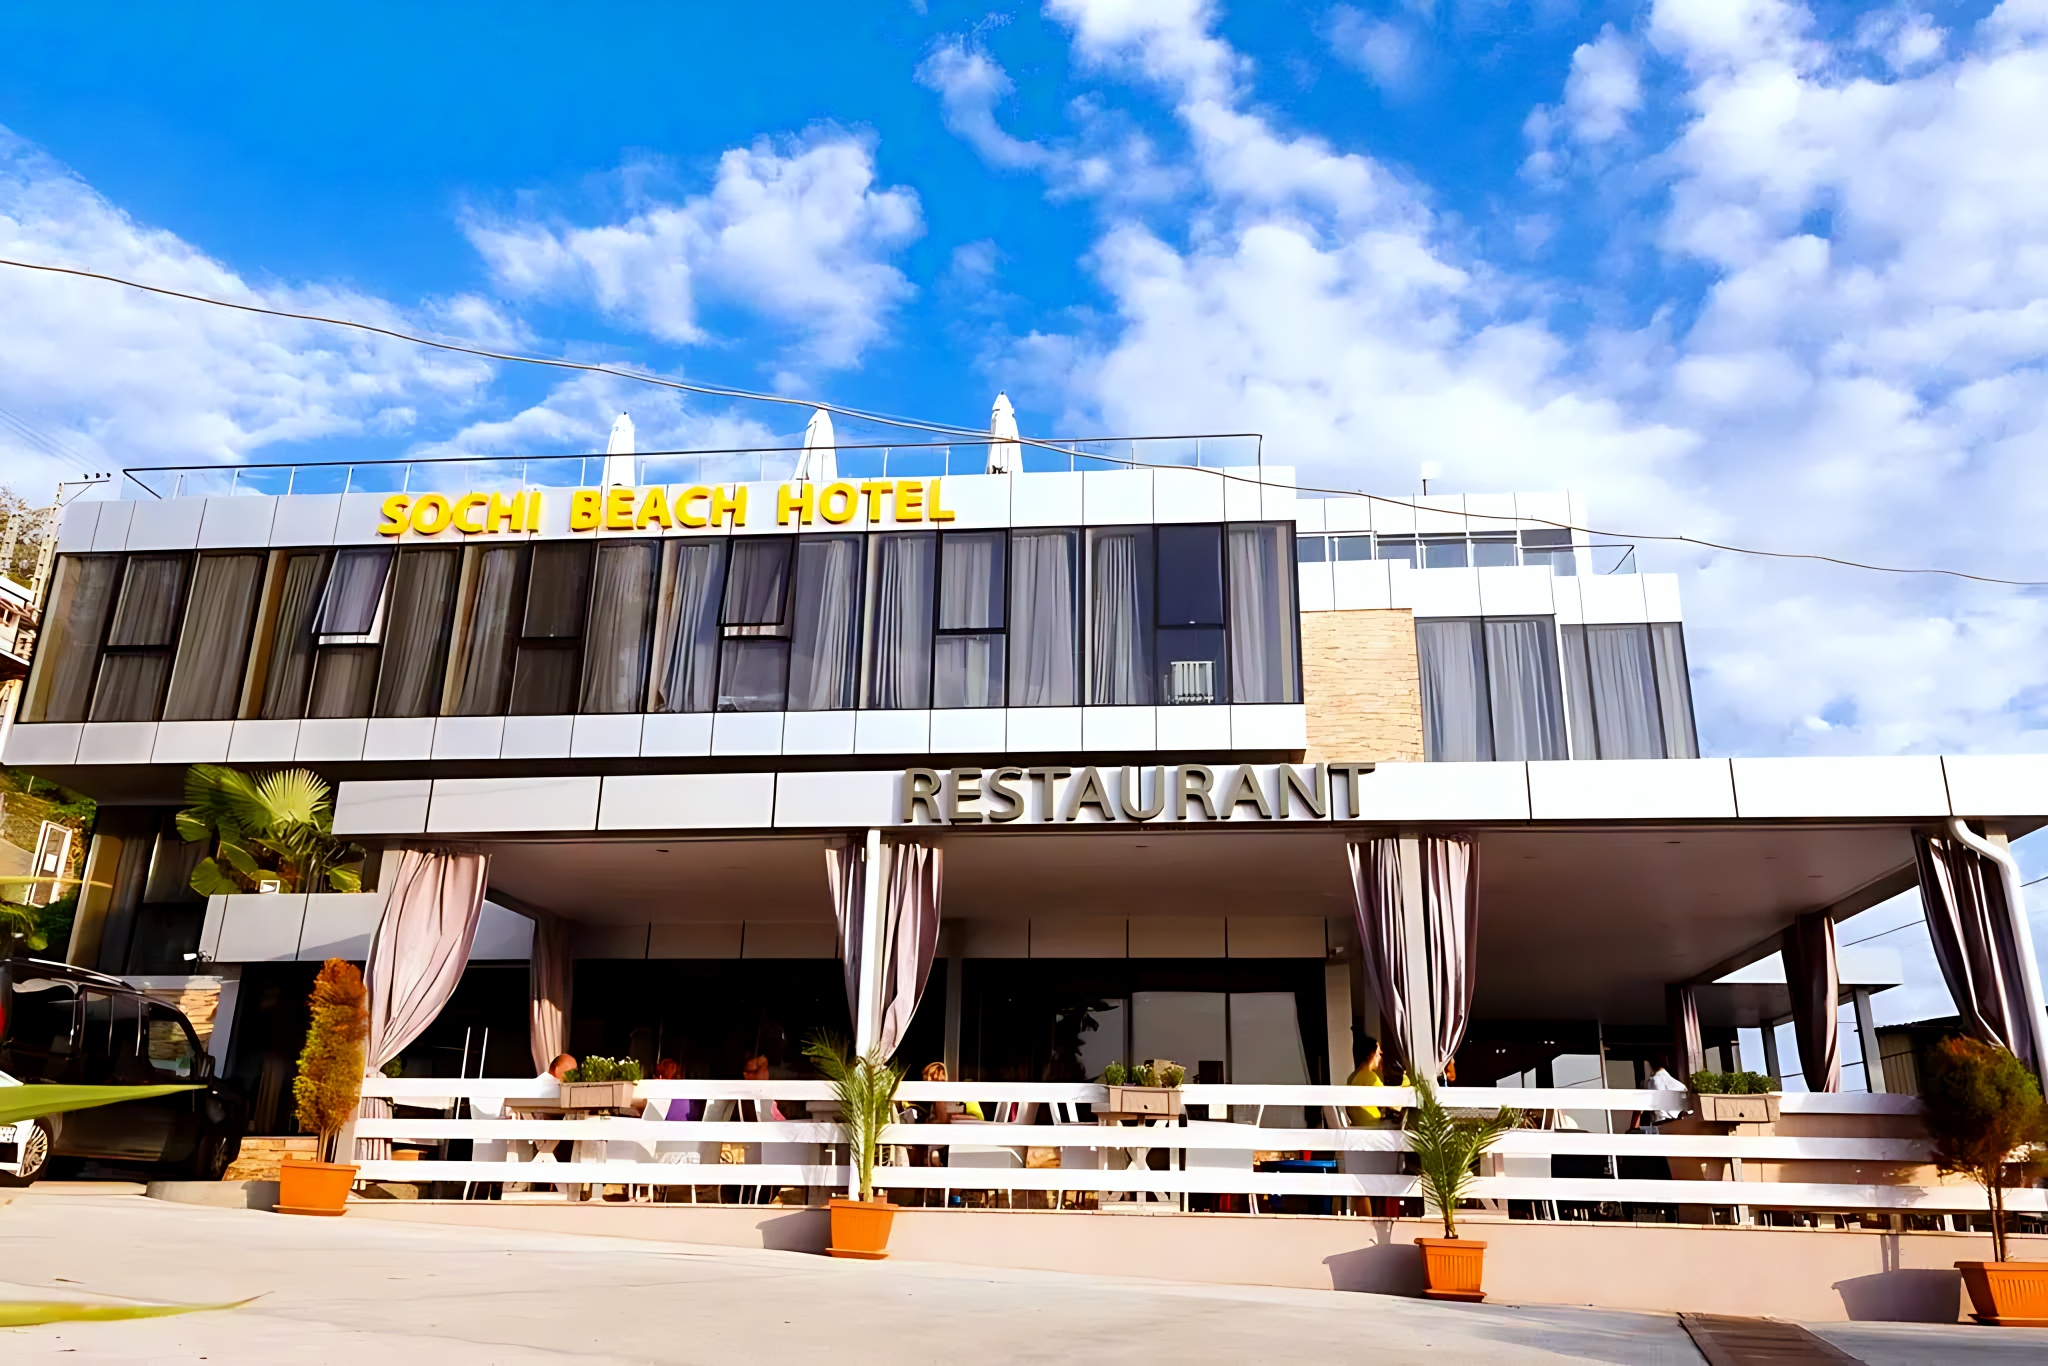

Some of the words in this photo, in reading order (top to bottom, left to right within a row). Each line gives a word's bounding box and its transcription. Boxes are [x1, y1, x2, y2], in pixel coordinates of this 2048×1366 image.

[378, 491, 541, 536] SOCHI
[570, 485, 747, 531] BEACH
[778, 479, 955, 525] HOTEL
[904, 763, 1376, 823] RESTAURANT
